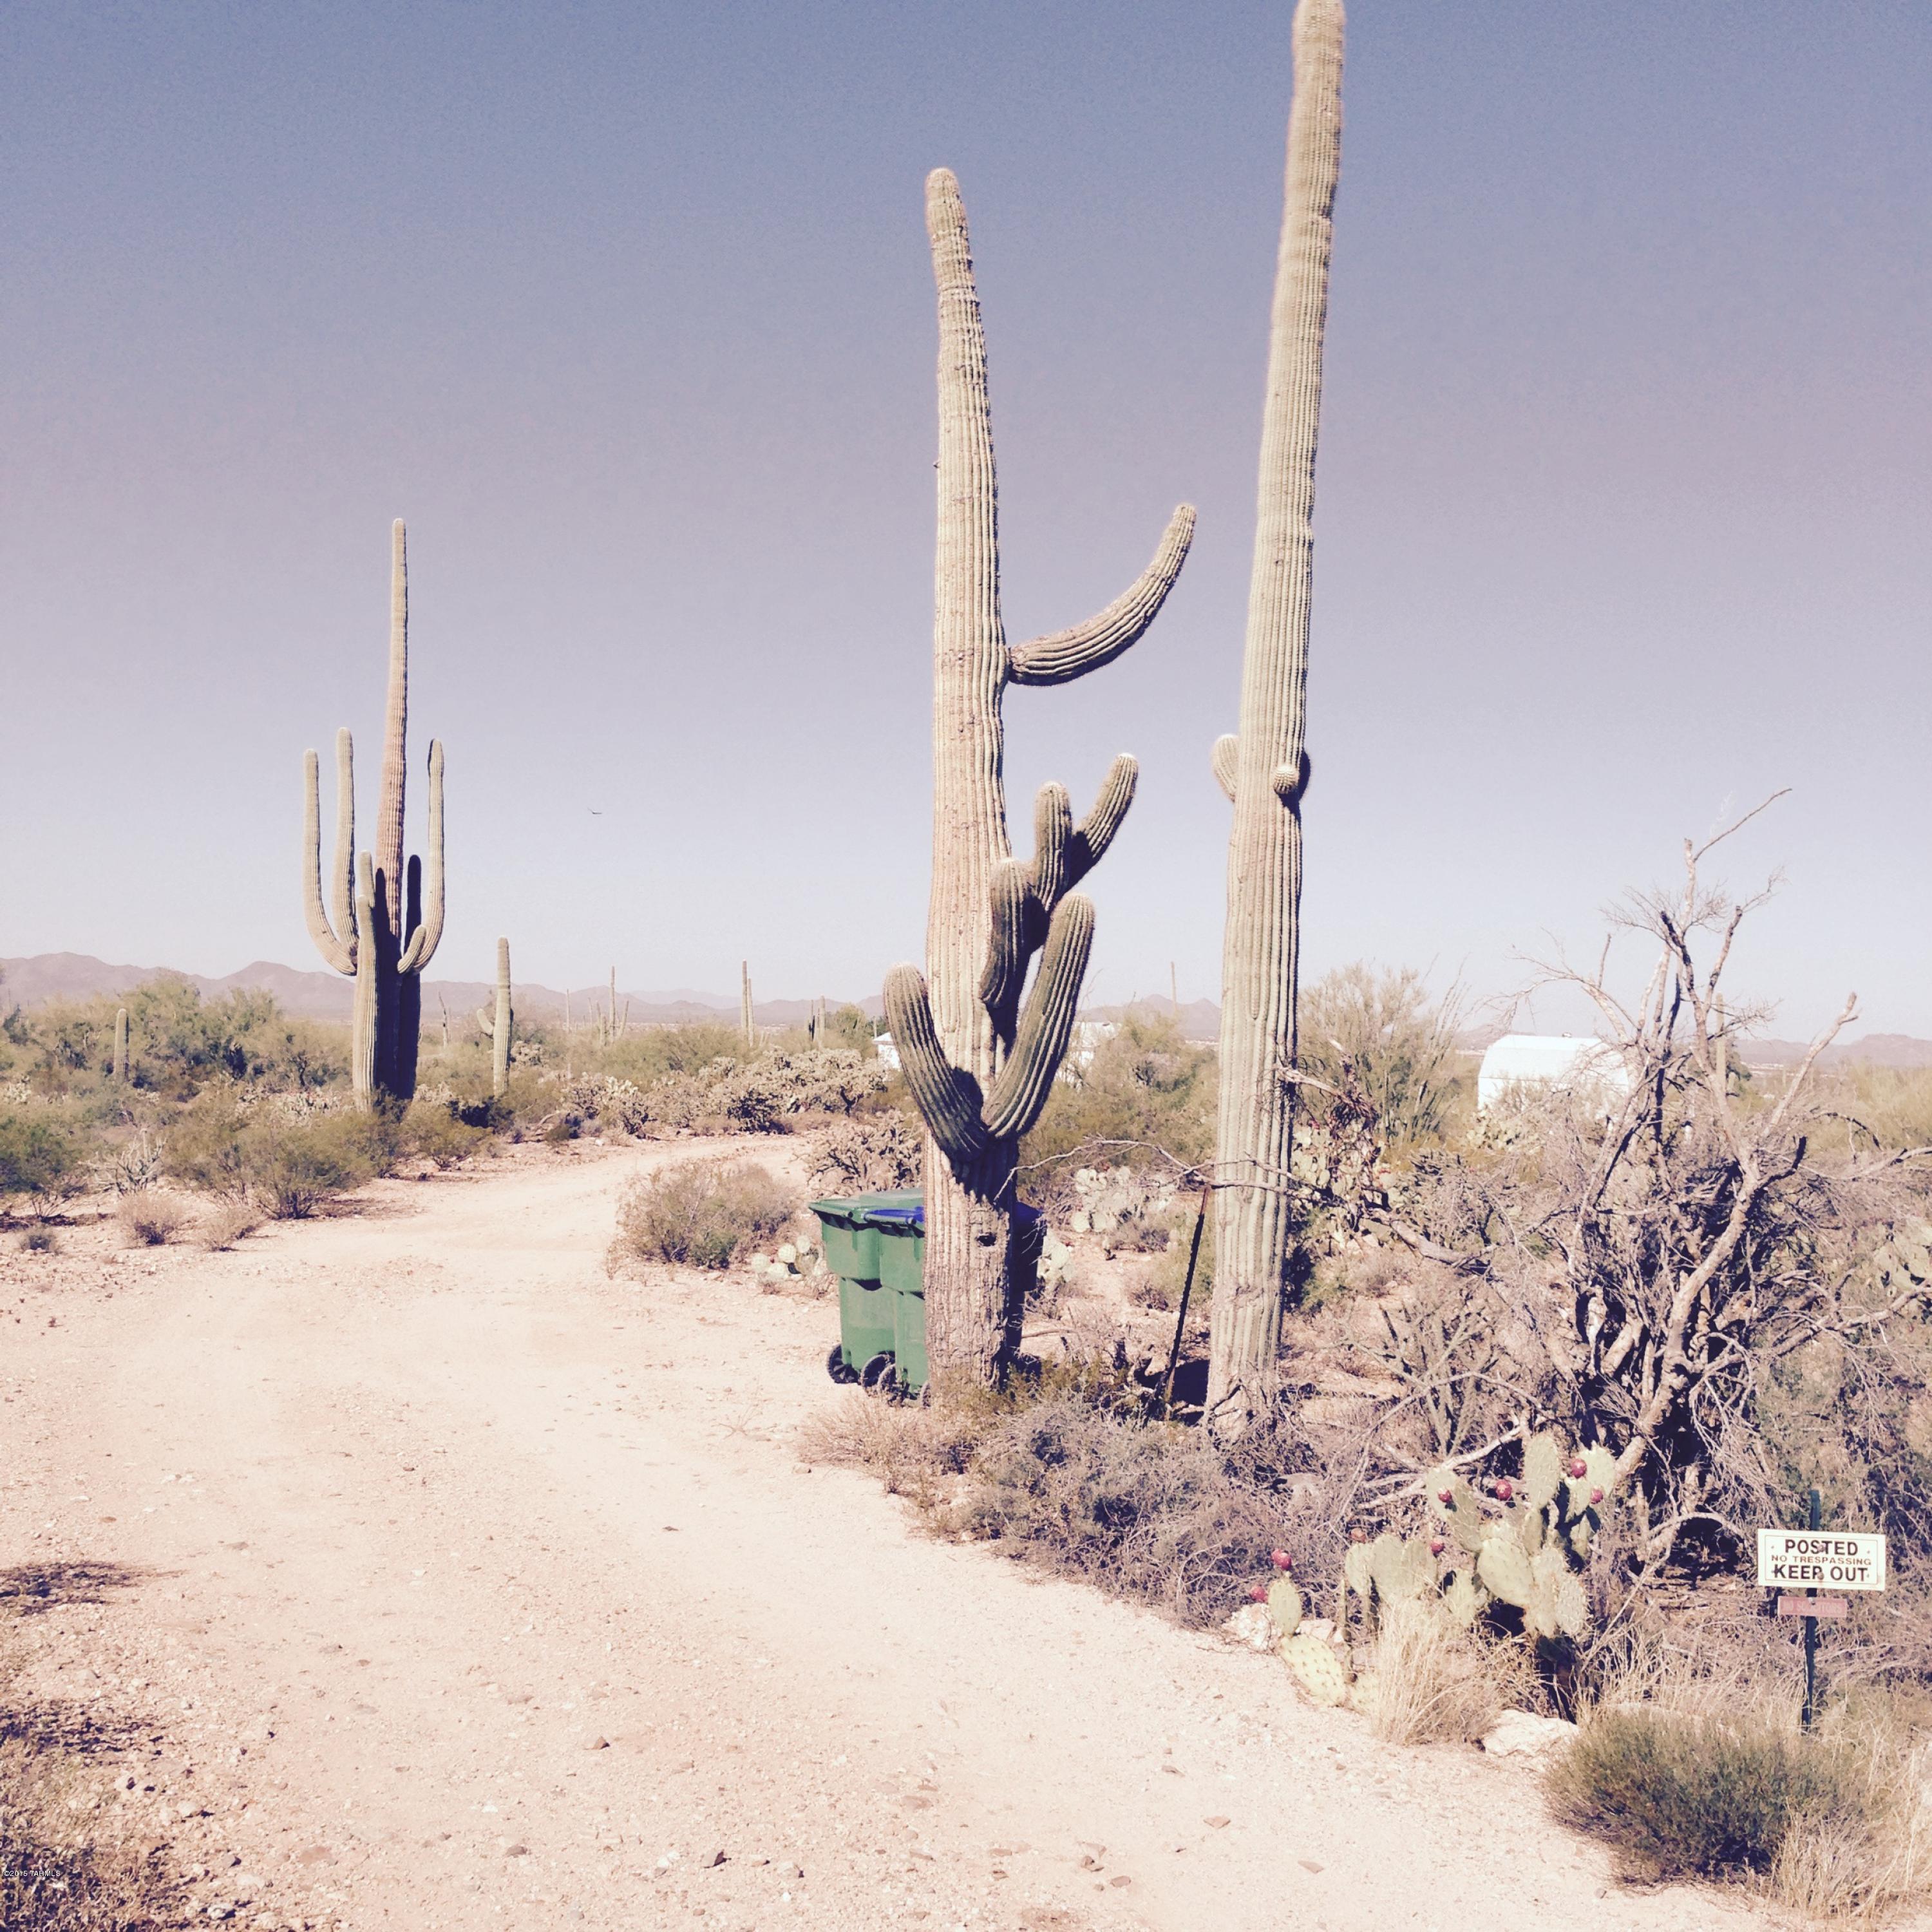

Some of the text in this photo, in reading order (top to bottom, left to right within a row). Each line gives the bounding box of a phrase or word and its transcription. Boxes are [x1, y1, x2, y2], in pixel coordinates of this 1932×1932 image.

[1785, 1539, 1858, 1555] POSTED
[1792, 1556, 1871, 1566] TRESPASSING
[1774, 1564, 1868, 1582] KEEP OUT
